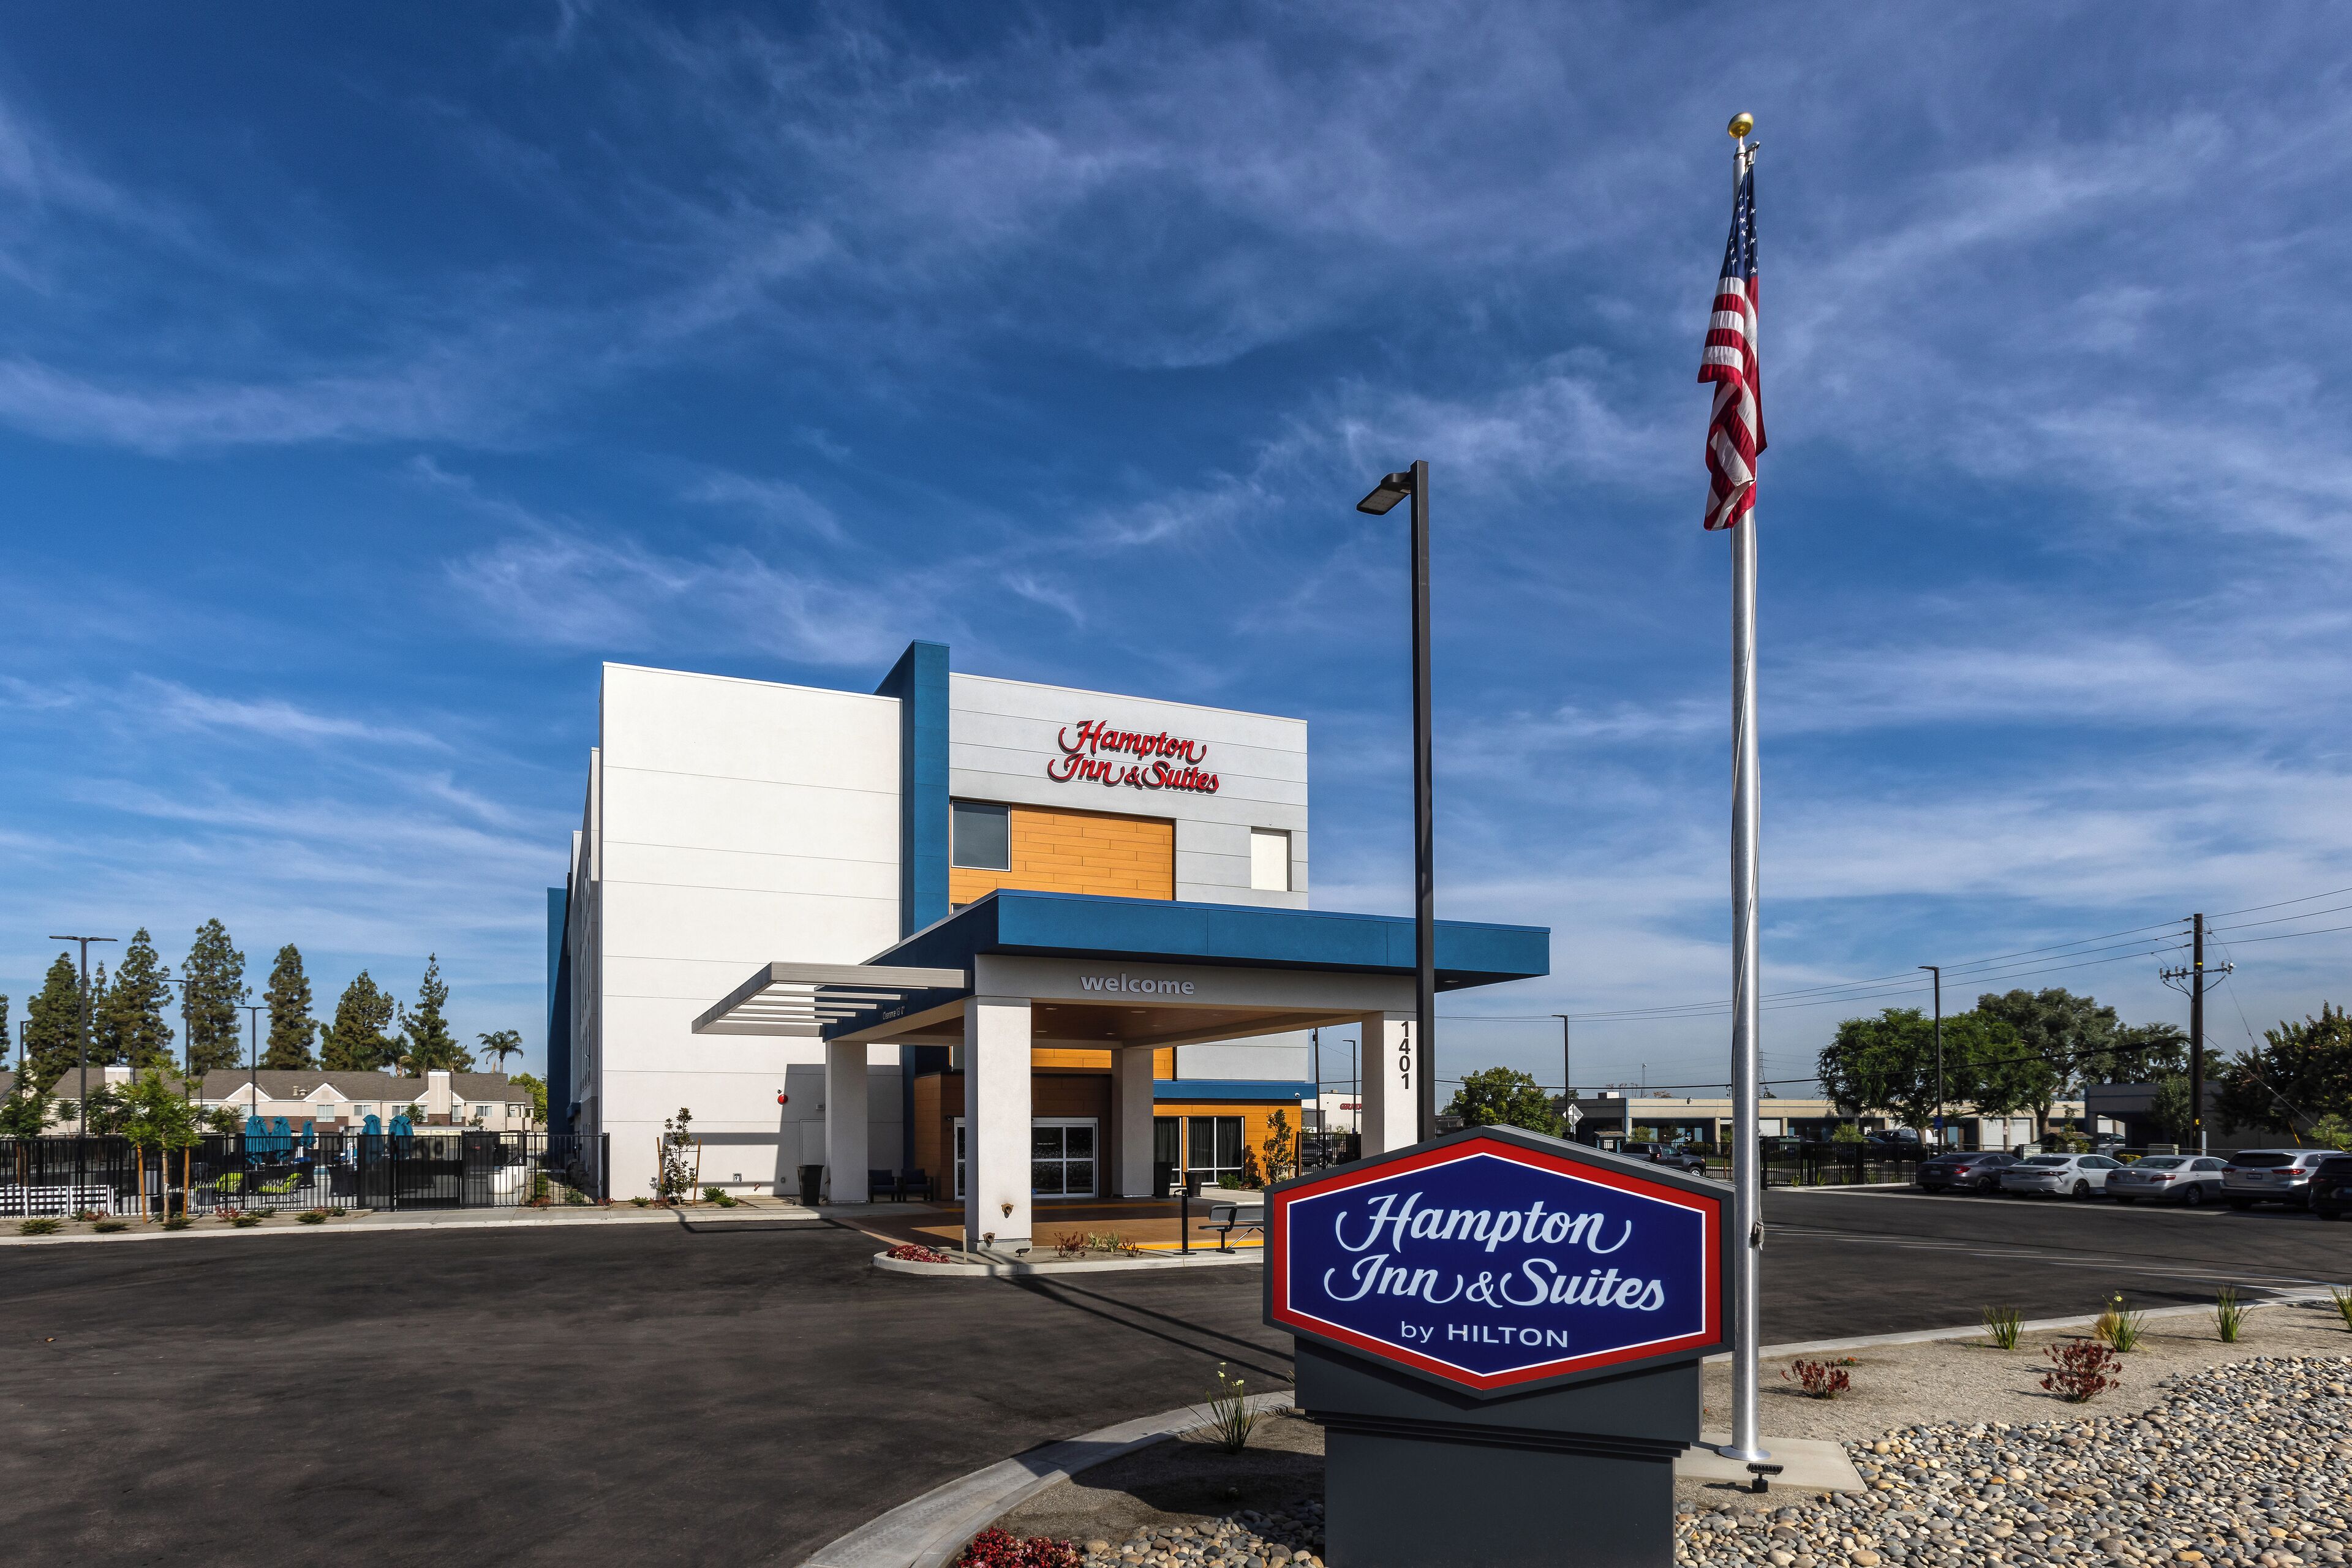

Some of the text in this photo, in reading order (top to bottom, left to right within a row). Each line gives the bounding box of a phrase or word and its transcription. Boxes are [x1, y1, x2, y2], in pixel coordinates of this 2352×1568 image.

[1058, 720, 1207, 765] Hampton
[1047, 753, 1219, 794] Inn & Suites
[1080, 973, 1194, 995] welcome
[1398, 1020, 1411, 1090] 1401
[1335, 1191, 1632, 1254] Hampton
[1324, 1254, 1665, 1311] Inn & Suites
[1401, 1321, 1567, 1348] by HILTON
